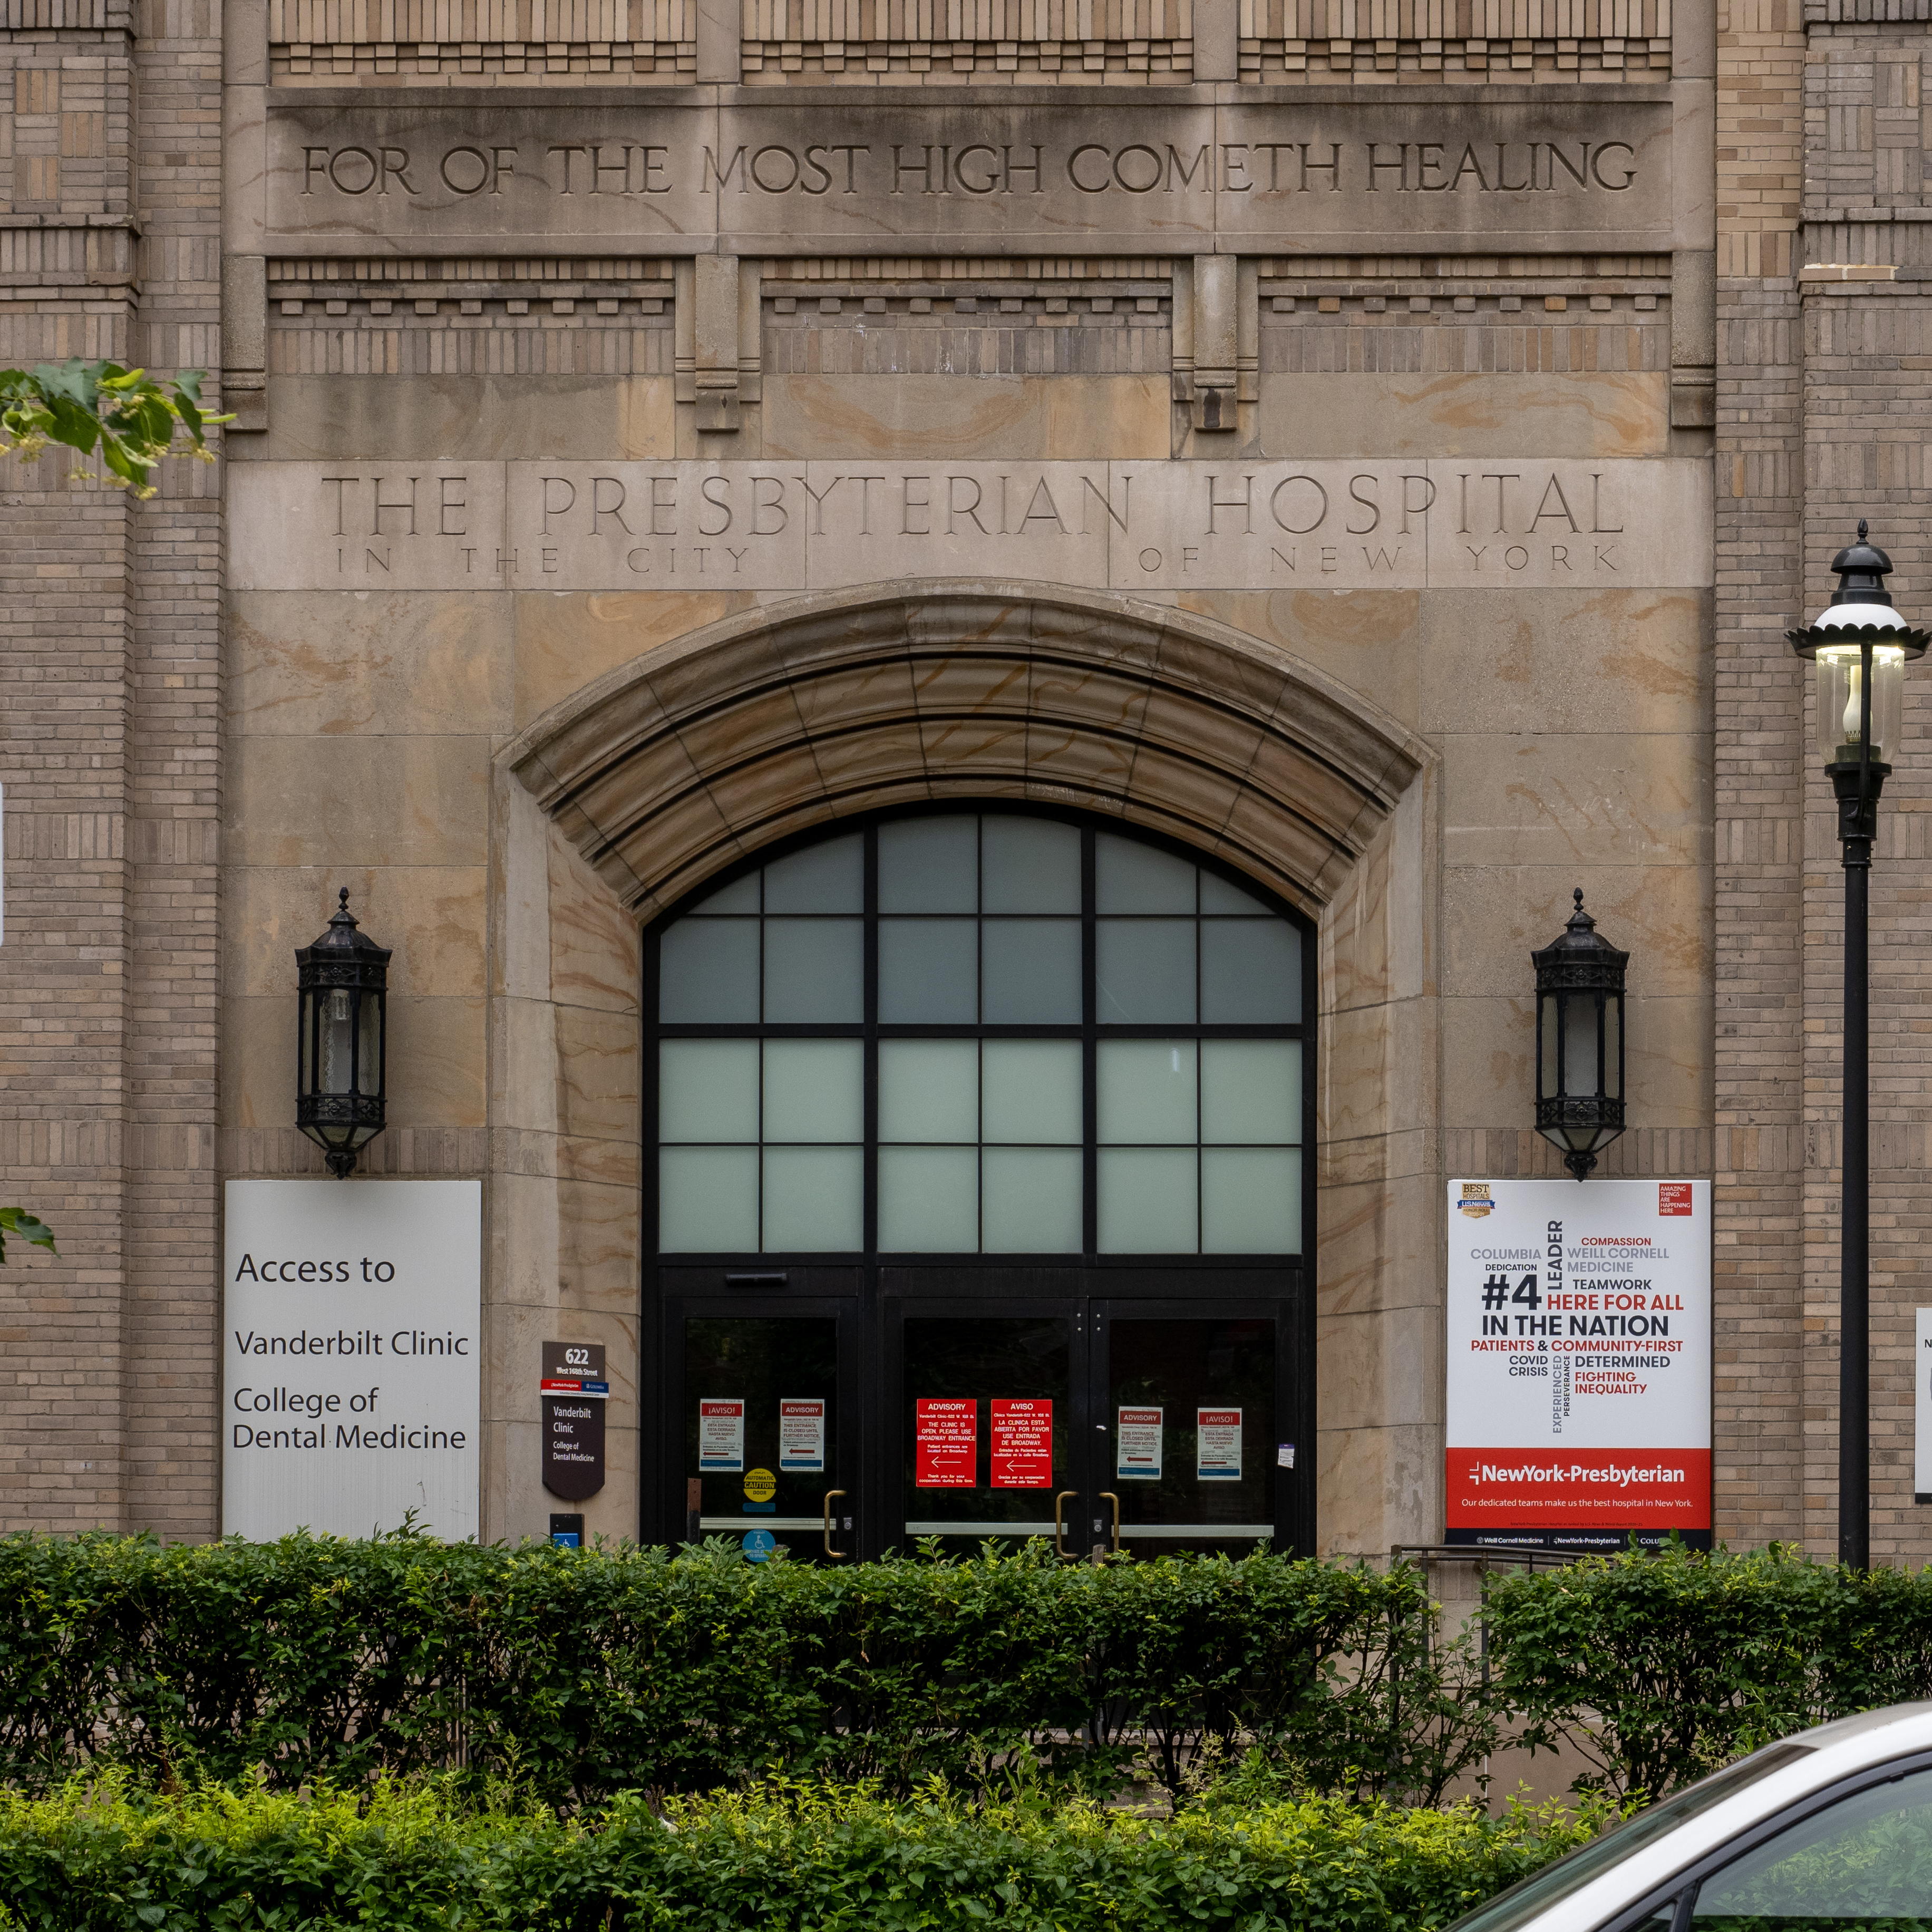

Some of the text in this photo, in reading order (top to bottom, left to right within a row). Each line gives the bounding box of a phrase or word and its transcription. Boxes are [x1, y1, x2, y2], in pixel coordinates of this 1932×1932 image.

[300, 141, 1637, 195] FOR OF THE MOST HIGH COMETH HEALING
[321, 473, 1624, 536] THE PRESBYTERIAN HOSPITAL
[338, 545, 1618, 574] IN THE CITY OF NEW YORK
[1463, 1184, 1489, 1193] BEST
[1581, 1237, 1651, 1246] COMPASSION
[1470, 1249, 1542, 1260] COLUMBIA
[1547, 1220, 1562, 1290] LEADER
[1567, 1248, 1669, 1259] WEILL CORNELL
[235, 1254, 395, 1283] Access to
[1567, 1261, 1633, 1273] MEDICINE
[1572, 1279, 1652, 1290] TEAMWORK
[1481, 1274, 1542, 1310] #4
[1548, 1294, 1684, 1310] HERE FOR ALL
[1482, 1315, 1669, 1336] IN THE NATION
[235, 1330, 469, 1355] Vanderbilt Clinic
[1471, 1340, 1683, 1352] PATIENTS & COMMUNITY-FIRST
[566, 1348, 588, 1364] 622
[1509, 1355, 1548, 1365] COVID
[1575, 1356, 1670, 1368] DETERMINED
[1509, 1366, 1548, 1376] CRISIS
[1575, 1372, 1636, 1382] FIGHTING
[1552, 1355, 1562, 1433] EXPERIENCED
[1575, 1384, 1647, 1395] INEQUALITY
[234, 1387, 379, 1419] College of
[554, 1406, 591, 1418] Vanderbilt
[554, 1422, 573, 1433] Clinic
[234, 1424, 467, 1449] Dental Medicine
[554, 1441, 572, 1451] College
[571, 1453, 594, 1462] Medicine
[1482, 1464, 1685, 1487] NewYork-Presbyterian
[1462, 1499, 1477, 1507] Our
[1478, 1499, 1517, 1507] dedicated
[1545, 1499, 1566, 1507] make
[1579, 1499, 1593, 1507] the
[1594, 1499, 1611, 1507] best
[1612, 1499, 1644, 1509] hospital
[1645, 1499, 1653, 1507] in
[1655, 1499, 1673, 1507] New
[1674, 1499, 1693, 1507] York.
